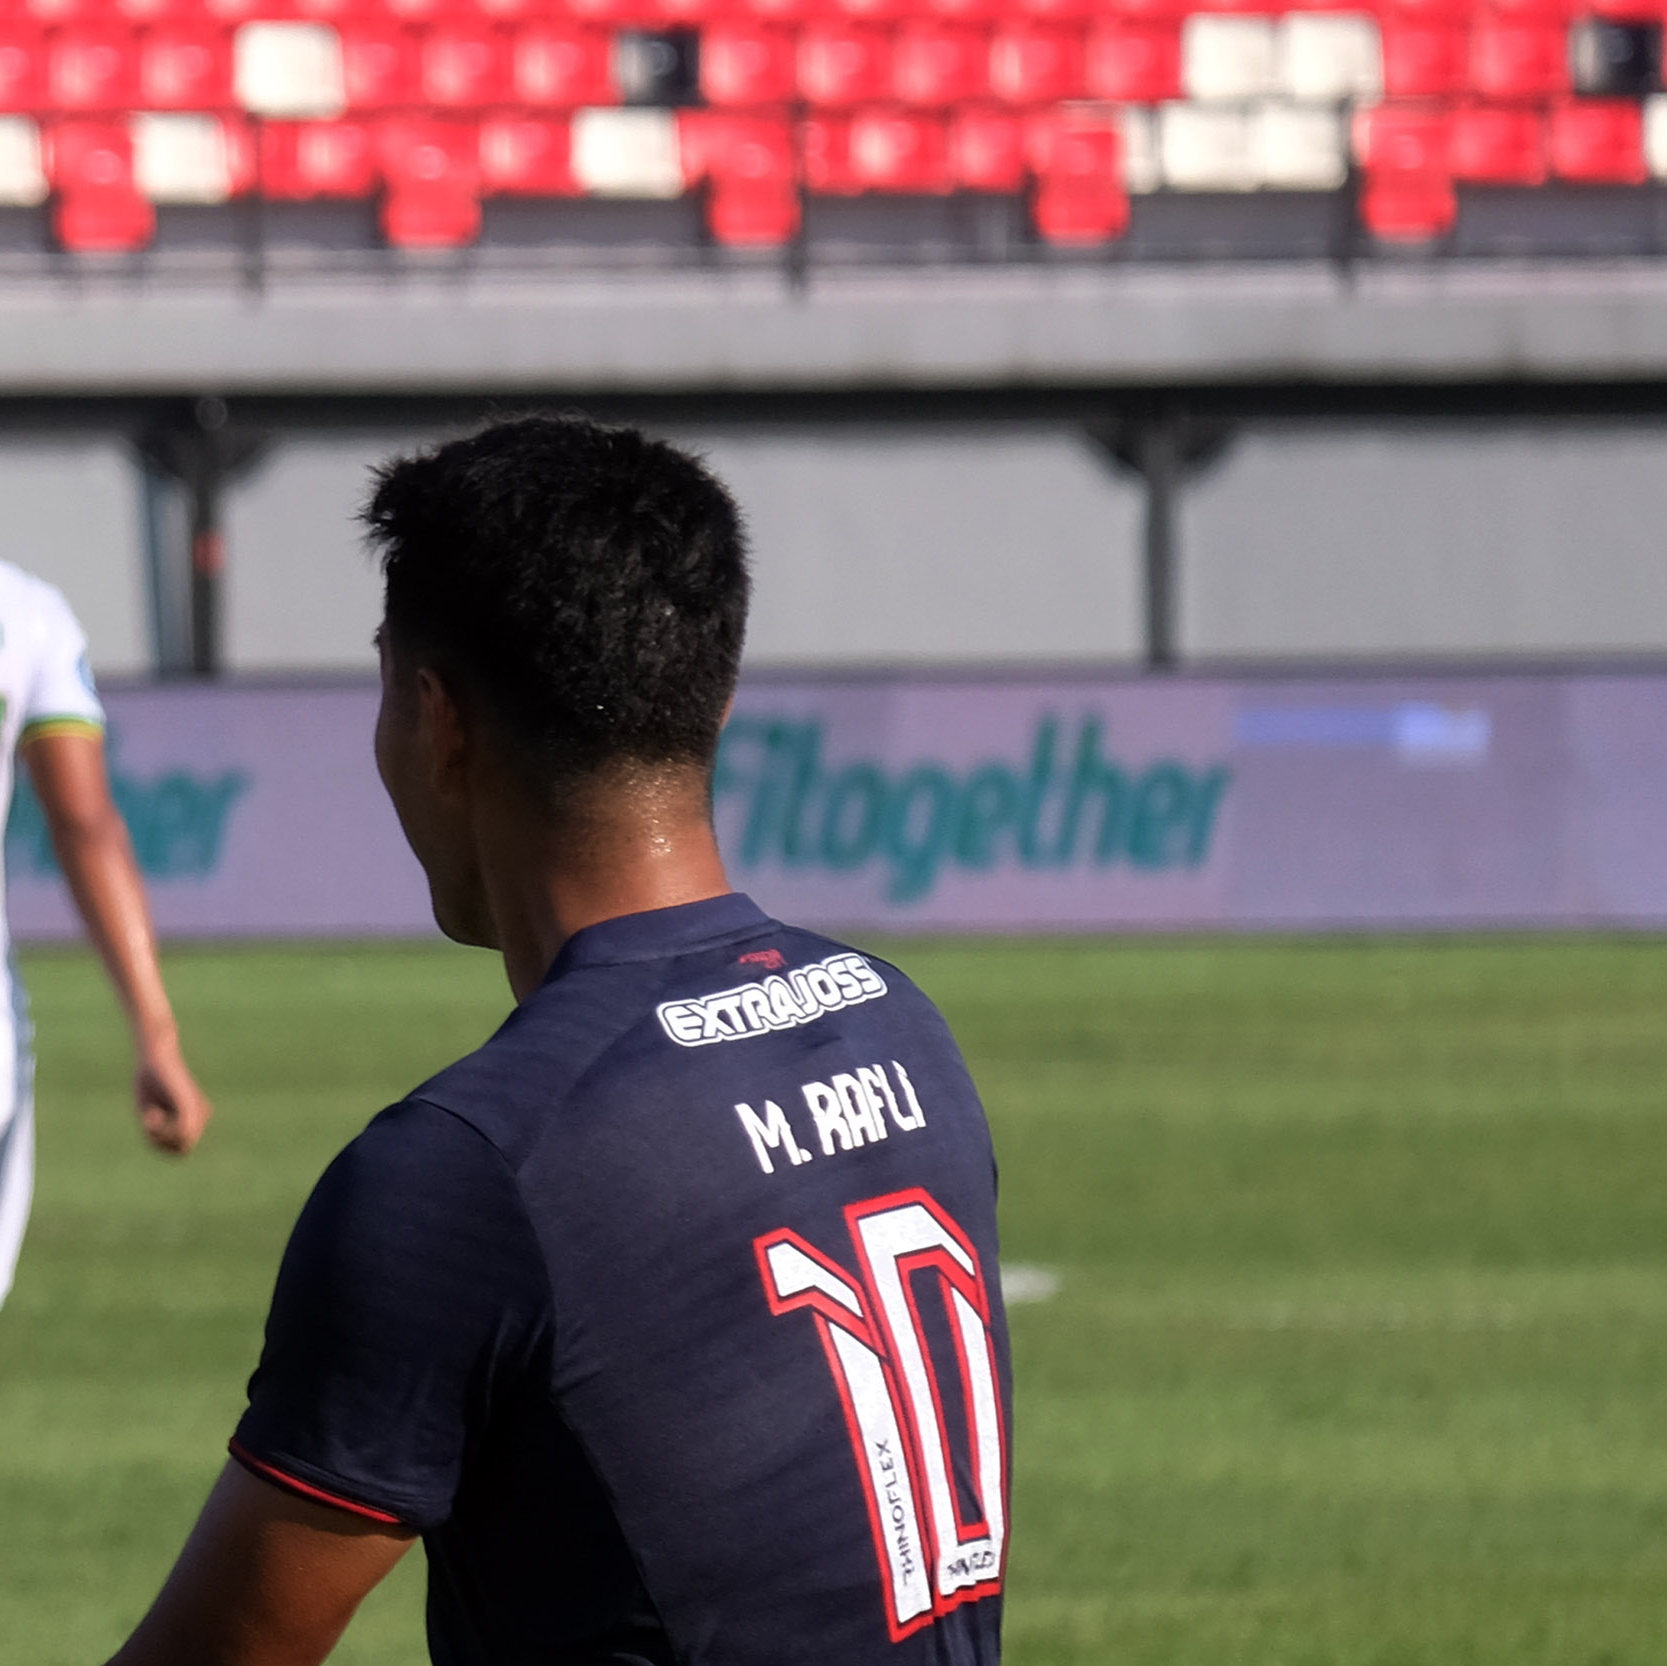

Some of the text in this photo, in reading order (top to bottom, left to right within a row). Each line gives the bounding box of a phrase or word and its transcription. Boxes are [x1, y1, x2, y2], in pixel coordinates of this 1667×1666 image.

[734, 1060, 927, 1174] M. RAFLI
[752, 1186, 1010, 1643] 10
